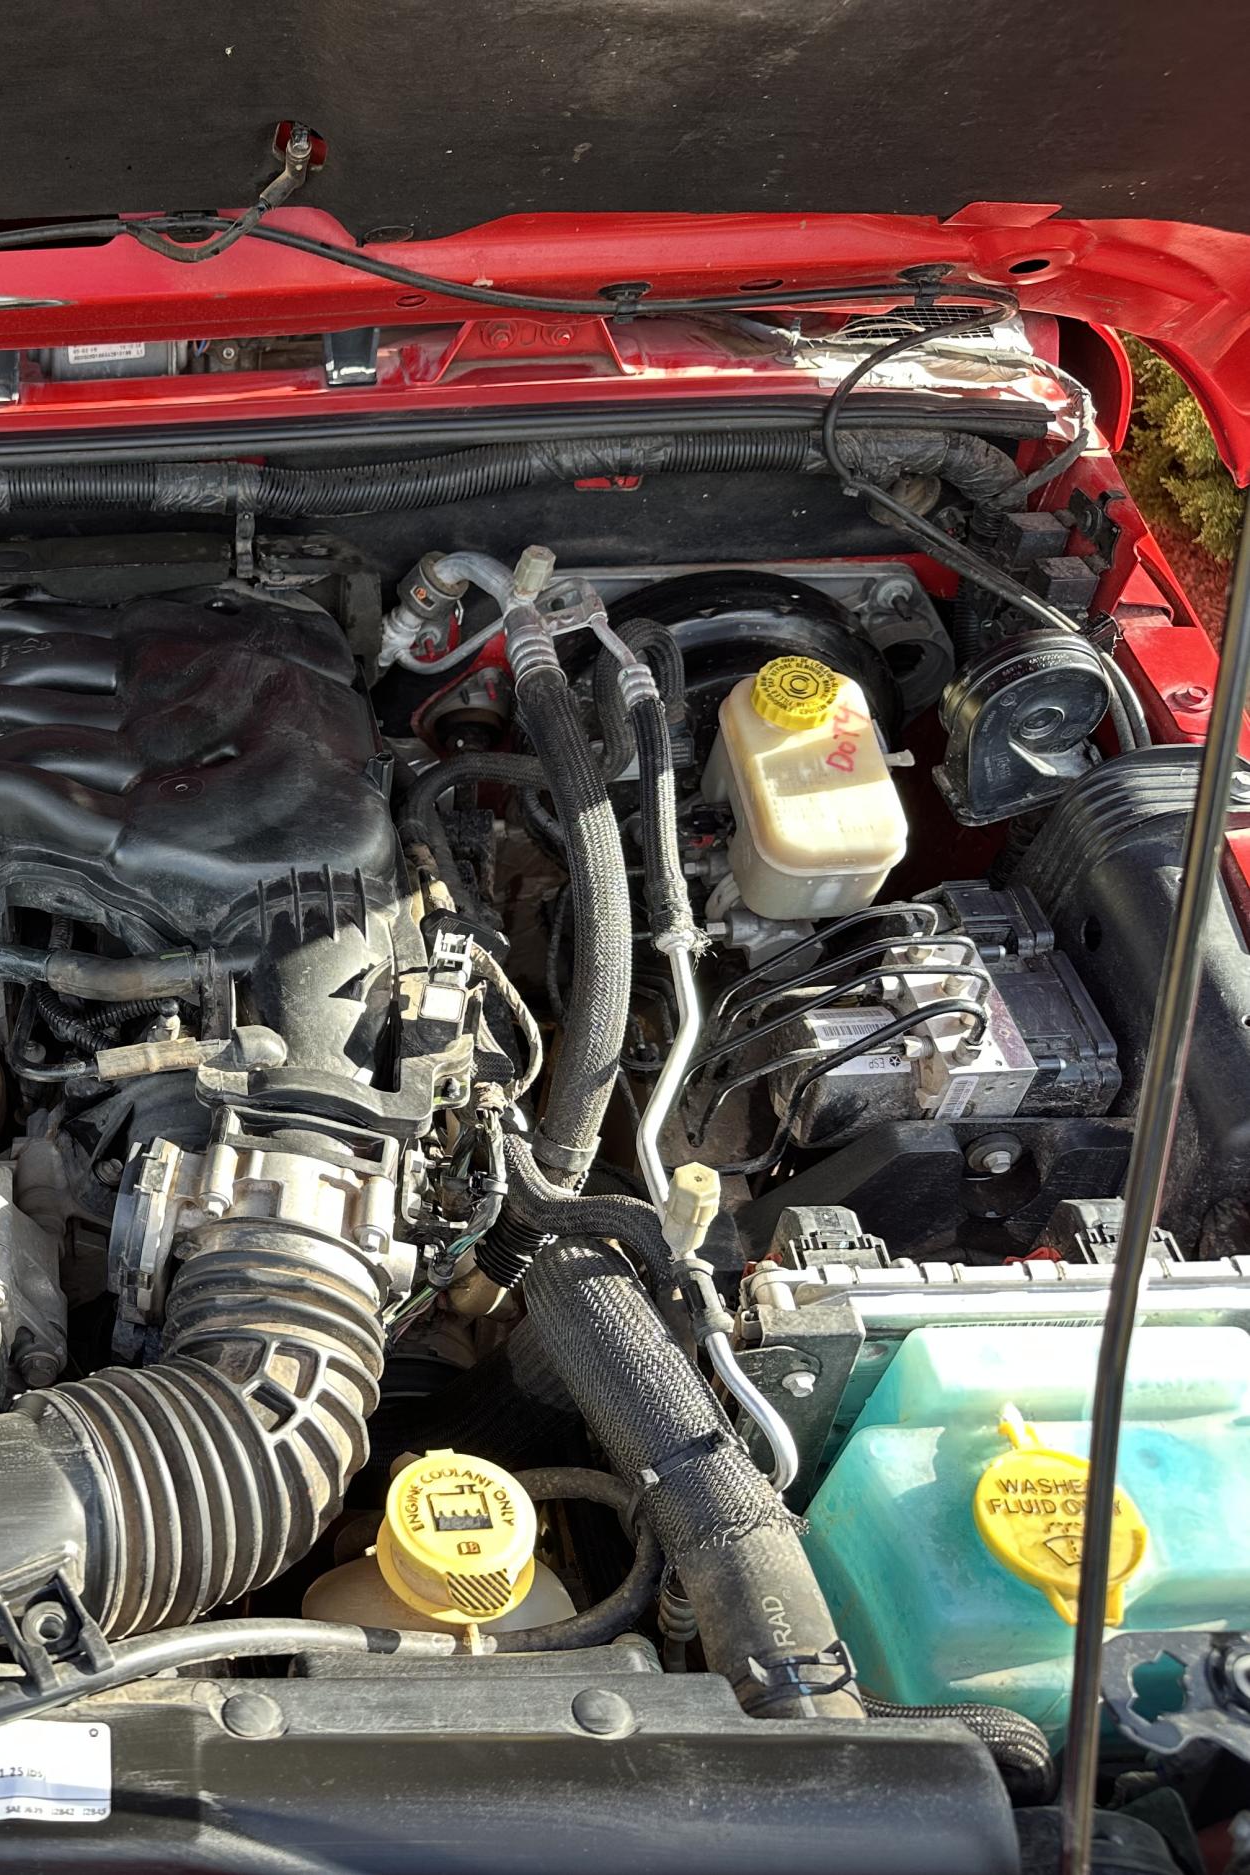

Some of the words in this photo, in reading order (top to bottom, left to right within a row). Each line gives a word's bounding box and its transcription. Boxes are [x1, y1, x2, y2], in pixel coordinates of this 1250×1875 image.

[869, 1057, 885, 1069] ESP
[995, 1478, 1087, 1495] WASHE
[405, 1484, 425, 1533] ENGINE
[420, 1468, 494, 1489] COOLANT
[493, 1486, 515, 1527] ONLY
[987, 1498, 1057, 1516] FLUID
[762, 1596, 796, 1647] RAD
[5, 1806, 22, 1814] SAE
